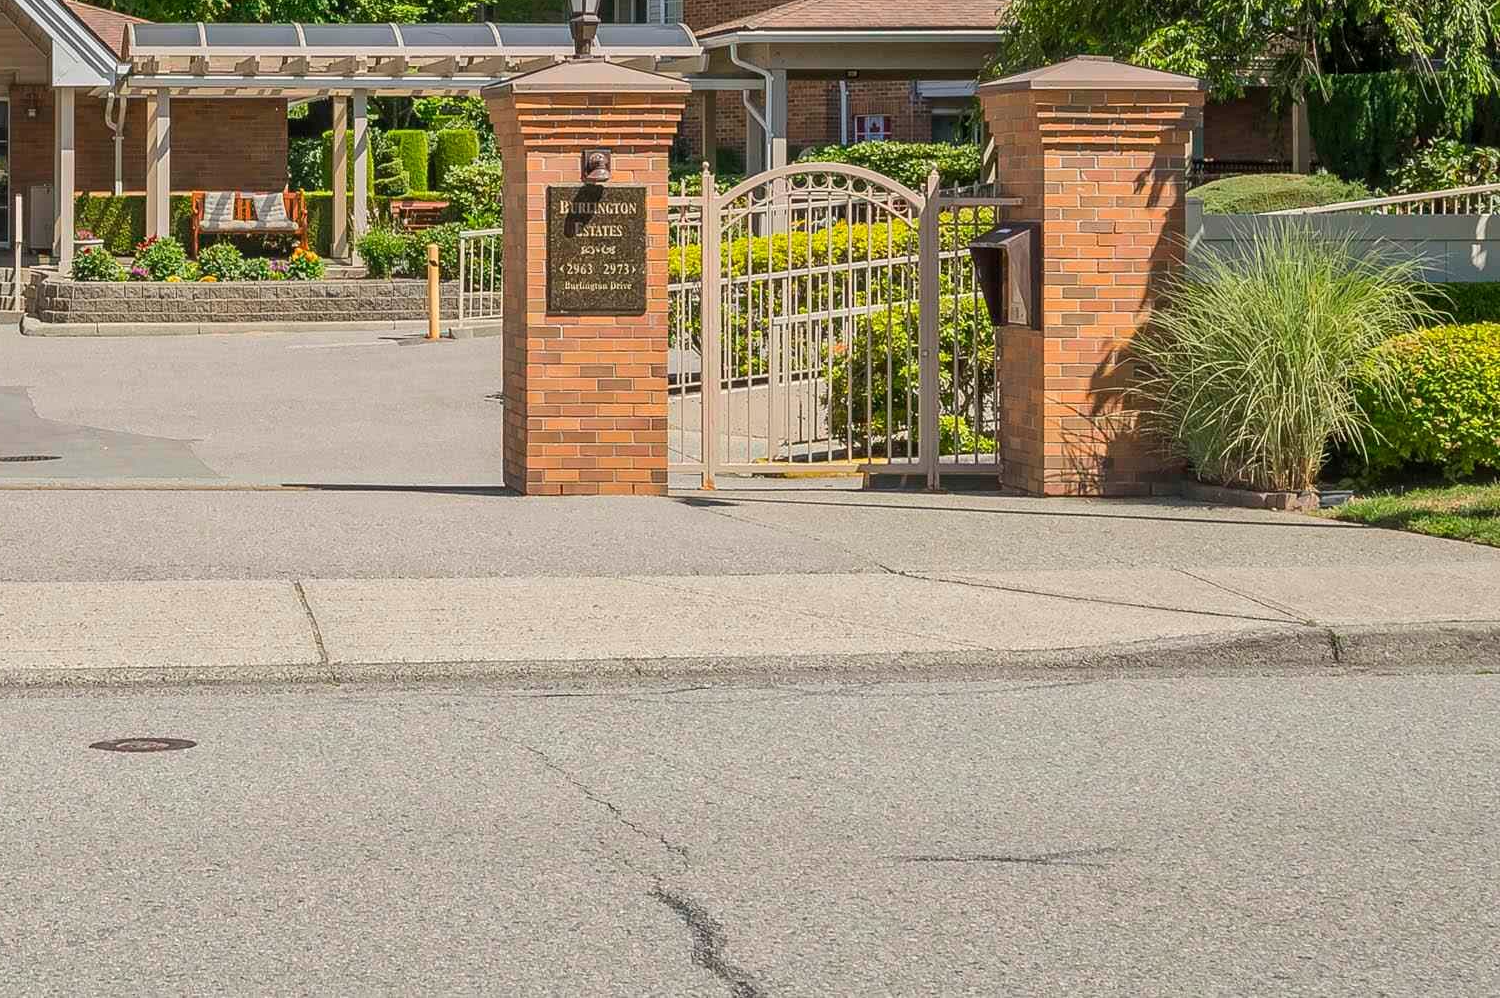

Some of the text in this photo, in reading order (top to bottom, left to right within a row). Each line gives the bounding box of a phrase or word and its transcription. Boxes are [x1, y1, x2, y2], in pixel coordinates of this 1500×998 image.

[560, 200, 637, 214] BURLINGTON
[575, 222, 623, 237] ESTATES
[610, 281, 633, 290] Drive
